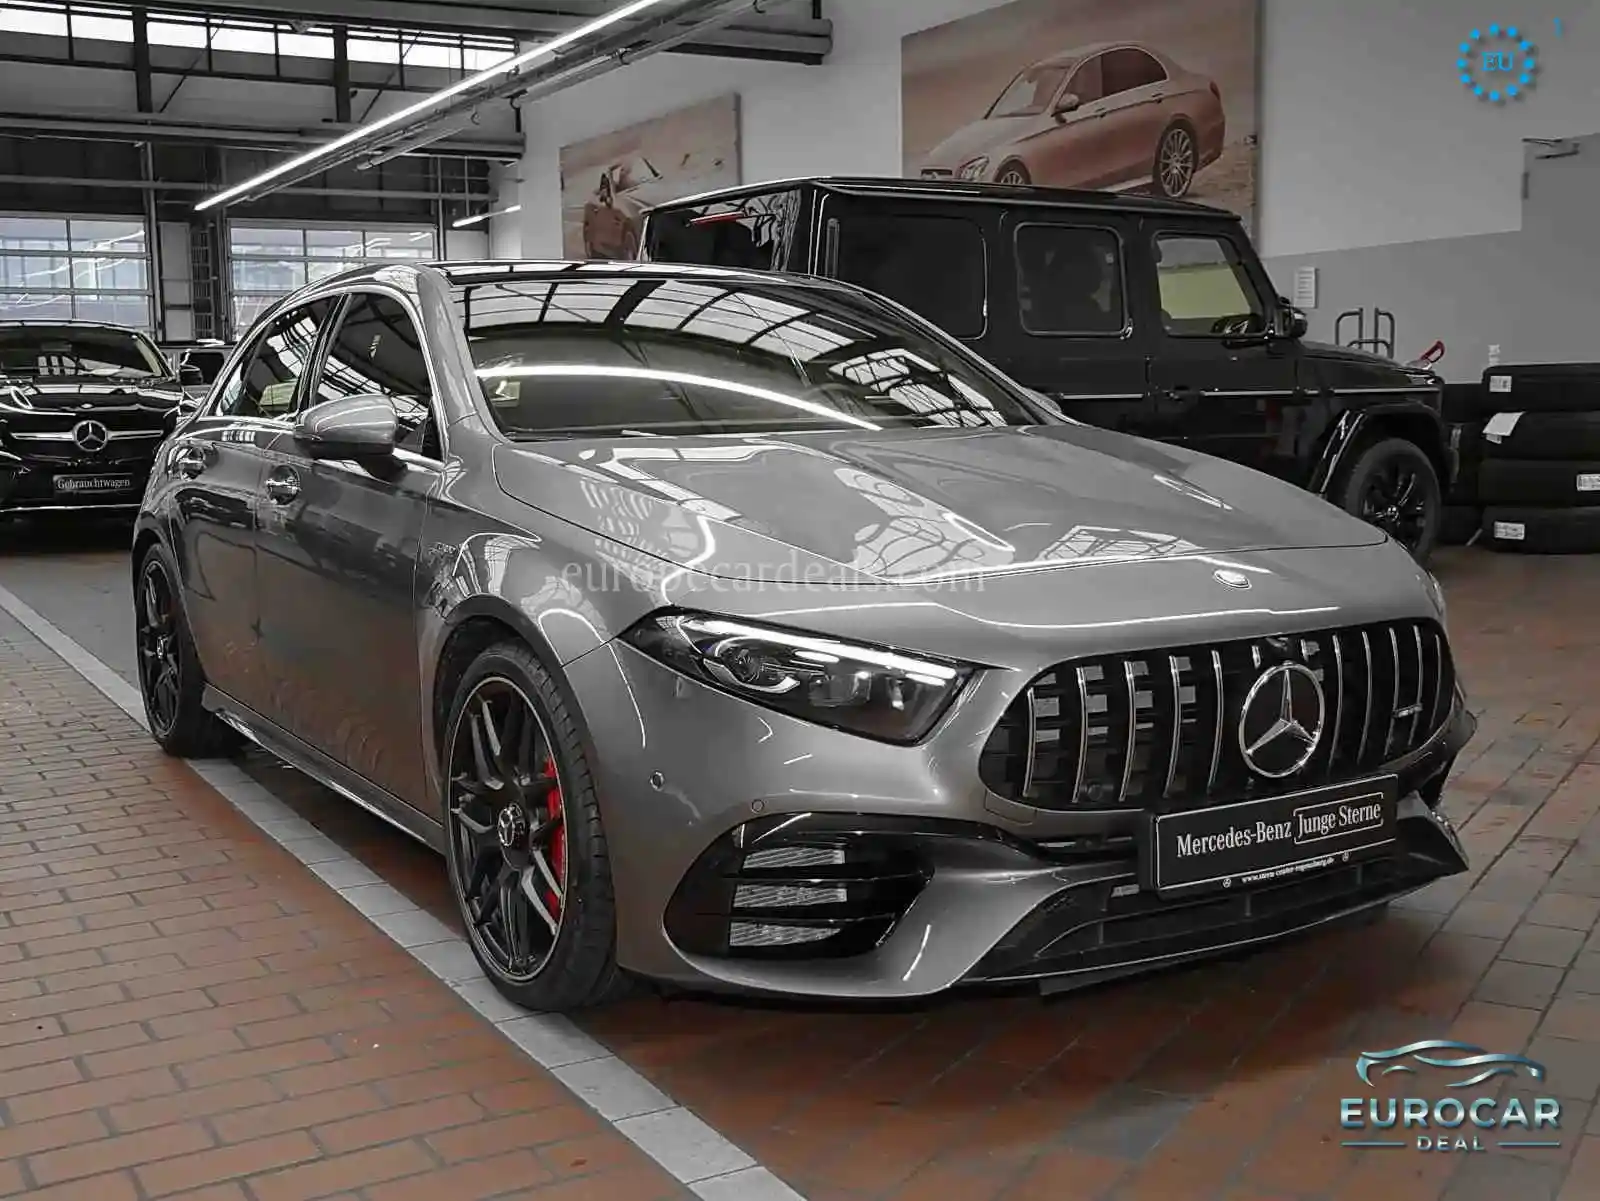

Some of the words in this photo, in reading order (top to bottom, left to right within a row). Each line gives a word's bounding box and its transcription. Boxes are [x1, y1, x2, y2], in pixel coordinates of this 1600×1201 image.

[57, 478, 131, 490] Gebrauchtwagen
[1176, 821, 1292, 858] Mercedes-Benz
[1297, 811, 1337, 838] Junge
[1338, 802, 1382, 827] Sterne
